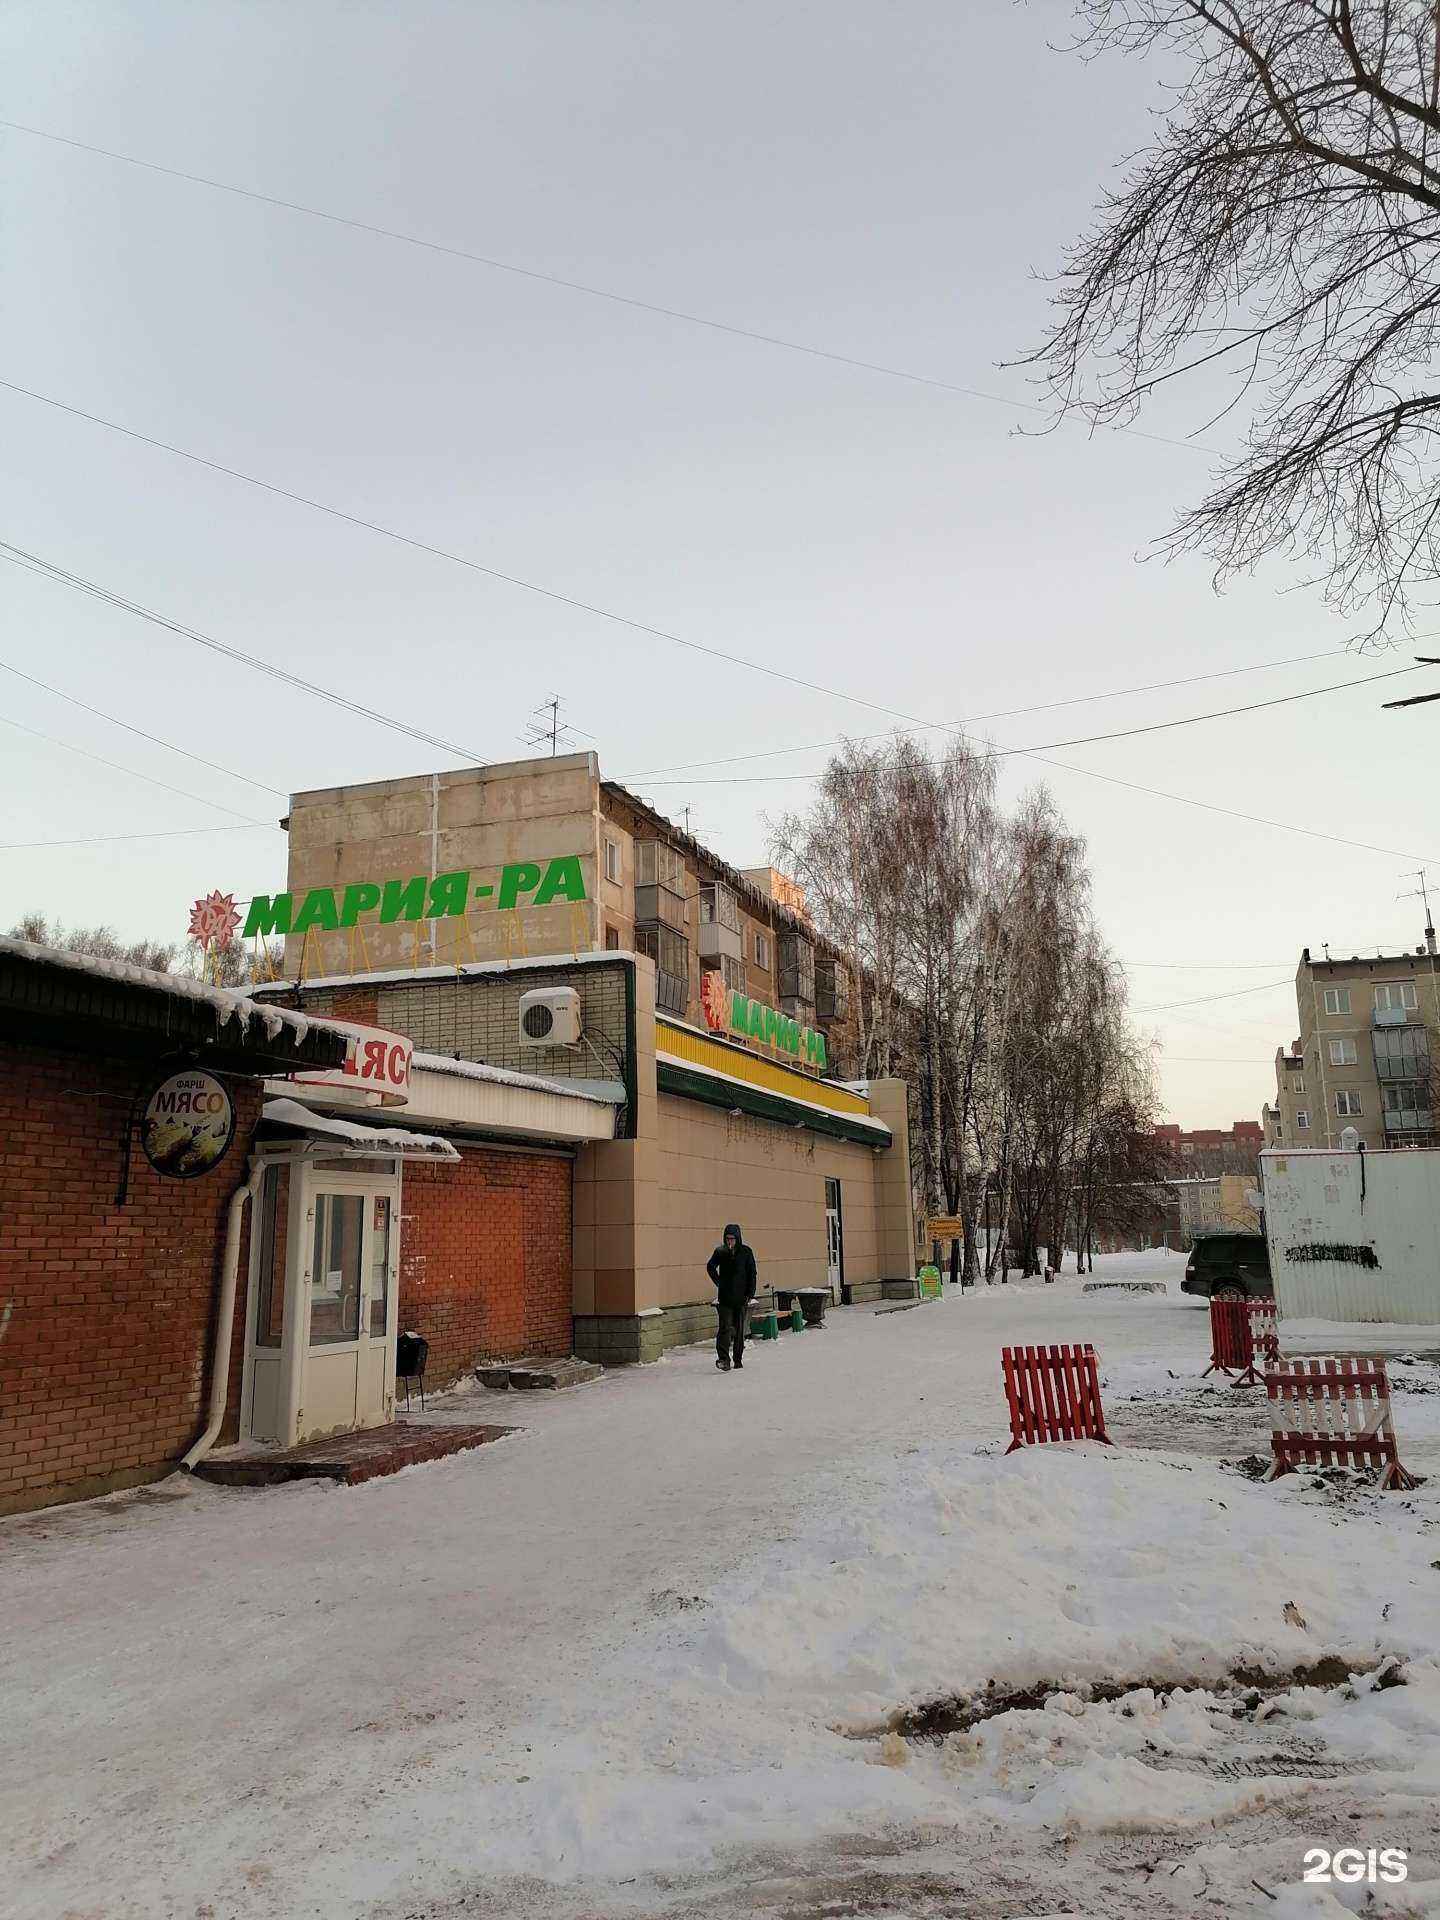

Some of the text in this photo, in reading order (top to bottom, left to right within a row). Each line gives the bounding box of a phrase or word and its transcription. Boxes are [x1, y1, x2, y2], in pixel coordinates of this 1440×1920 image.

[242, 855, 586, 938] МАРИЯ-РА
[176, 1079, 205, 1089] ФАРШ
[155, 1092, 224, 1113] МЯСО
